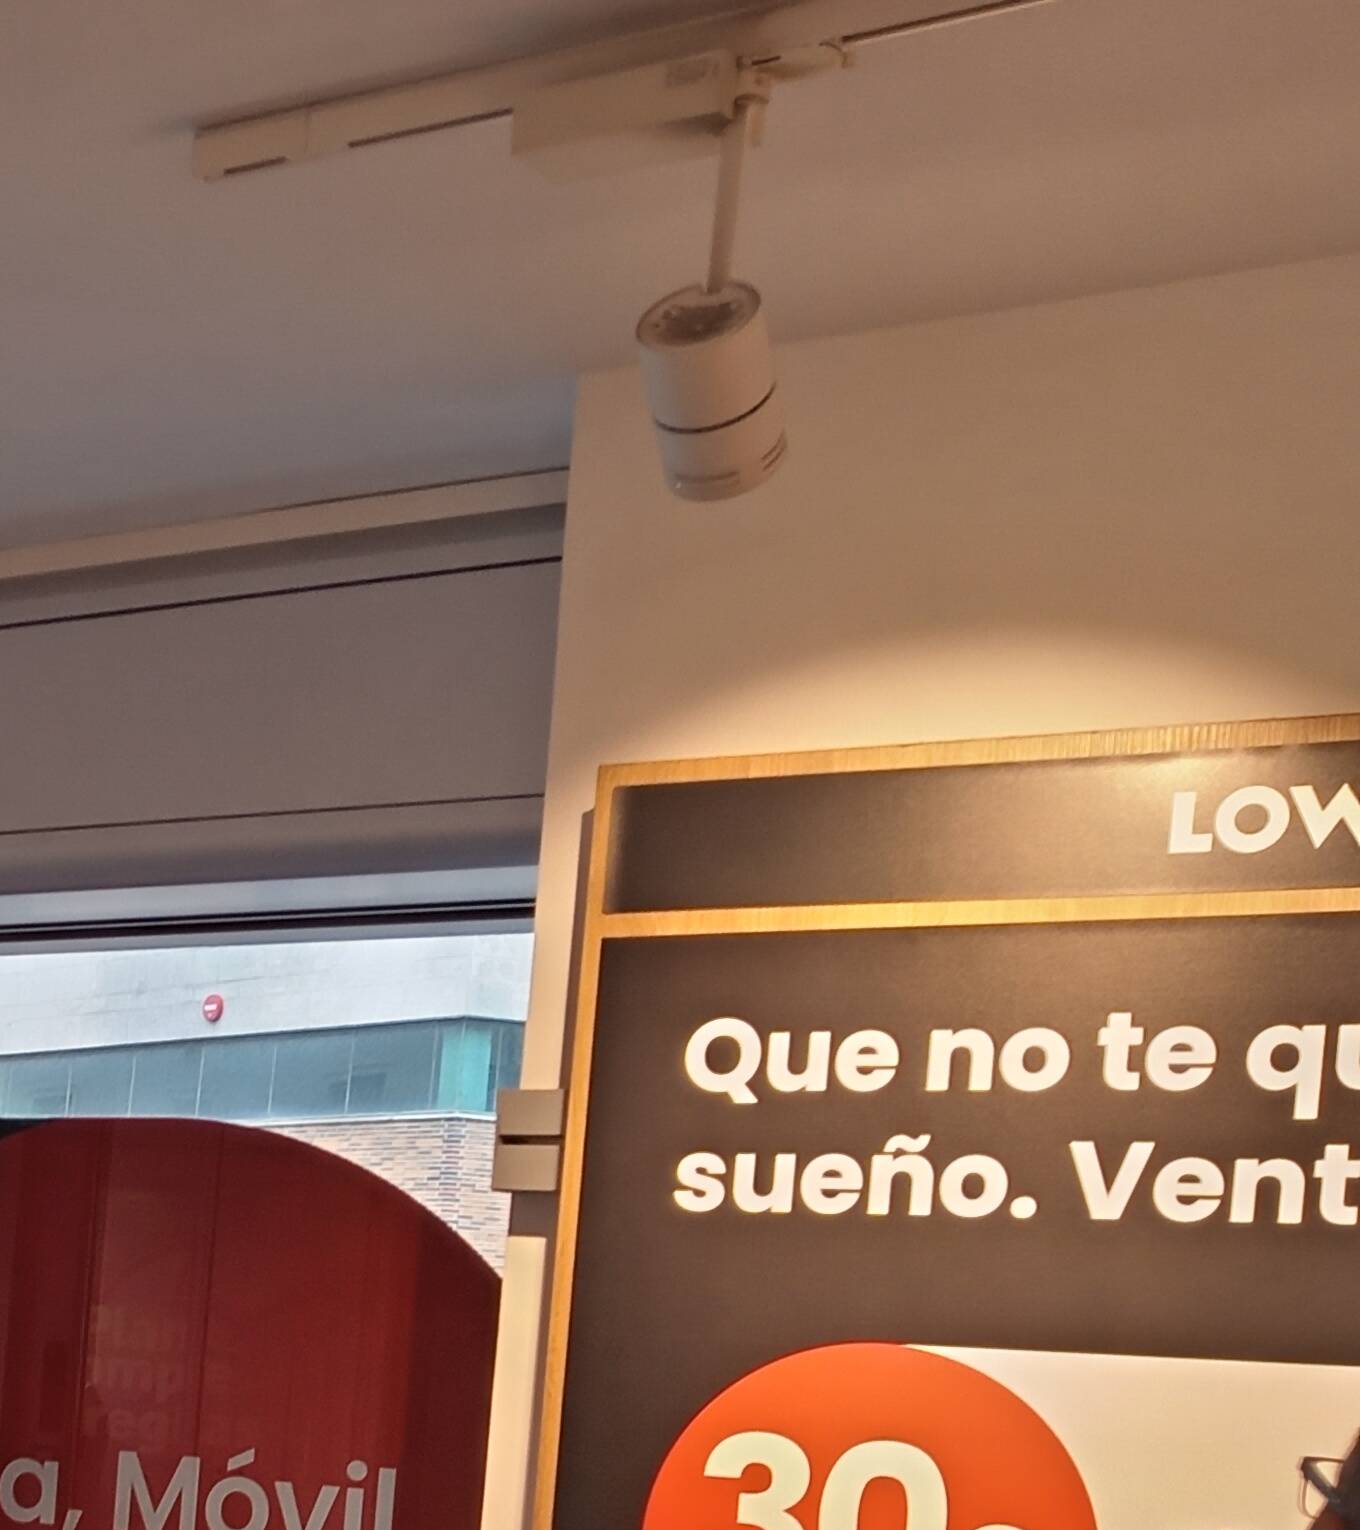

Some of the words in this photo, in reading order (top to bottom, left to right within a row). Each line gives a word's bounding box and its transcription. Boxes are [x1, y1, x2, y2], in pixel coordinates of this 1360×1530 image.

[683, 1016, 900, 1104] Que
[925, 1022, 1071, 1094] no
[1096, 1011, 1218, 1093] te
[672, 1133, 1038, 1220] sueño.
